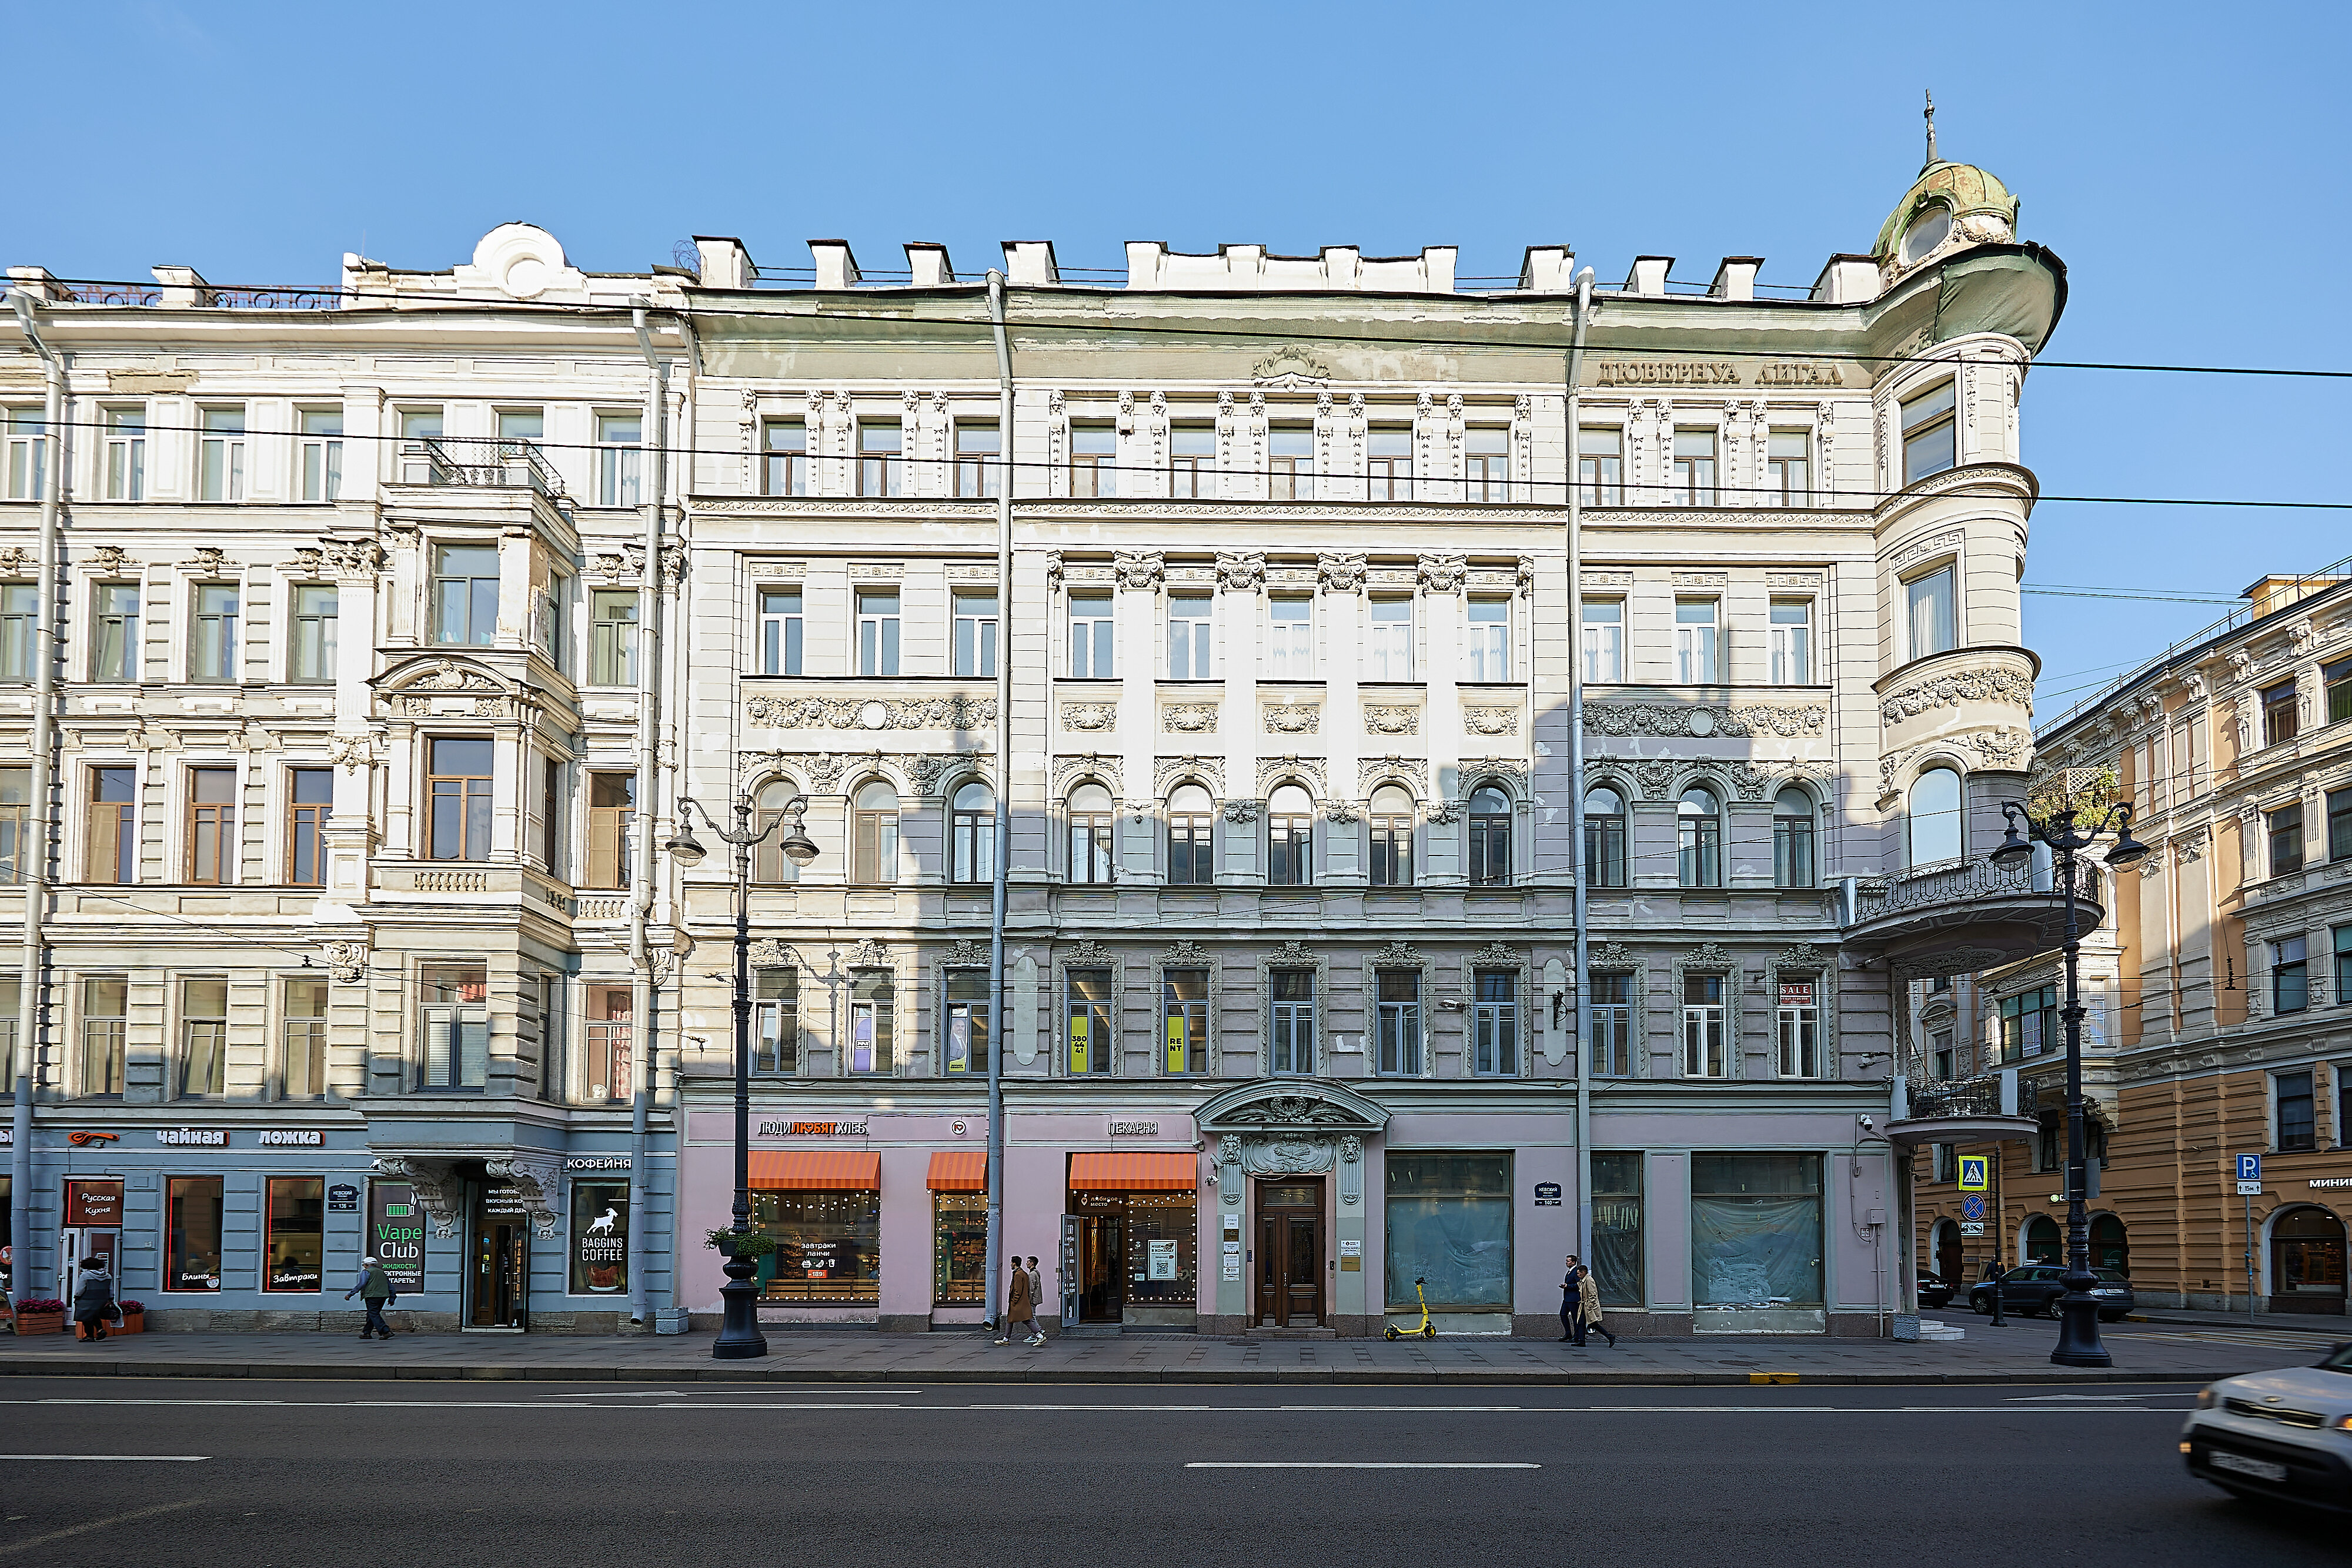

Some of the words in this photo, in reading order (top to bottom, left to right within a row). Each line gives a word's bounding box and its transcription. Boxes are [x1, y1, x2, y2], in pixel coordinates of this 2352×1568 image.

[1597, 363, 1742, 387] ДЮВЕРНУА
[1108, 1122, 1158, 1134] ПЕКАРНЯ
[156, 1128, 224, 1144] чайная
[259, 1131, 320, 1144] ложка
[567, 1157, 632, 1168] КОФЕЙНЯ
[2243, 1156, 2256, 1177] P
[82, 1193, 115, 1203] Русская
[85, 1207, 111, 1216] Кухня
[377, 1223, 422, 1243] Vape
[582, 1238, 623, 1248] BAGGINS
[380, 1242, 419, 1258] Club
[582, 1249, 623, 1261] COFFEE
[182, 1272, 209, 1281] Блины
[273, 1273, 318, 1283] Завтраки
